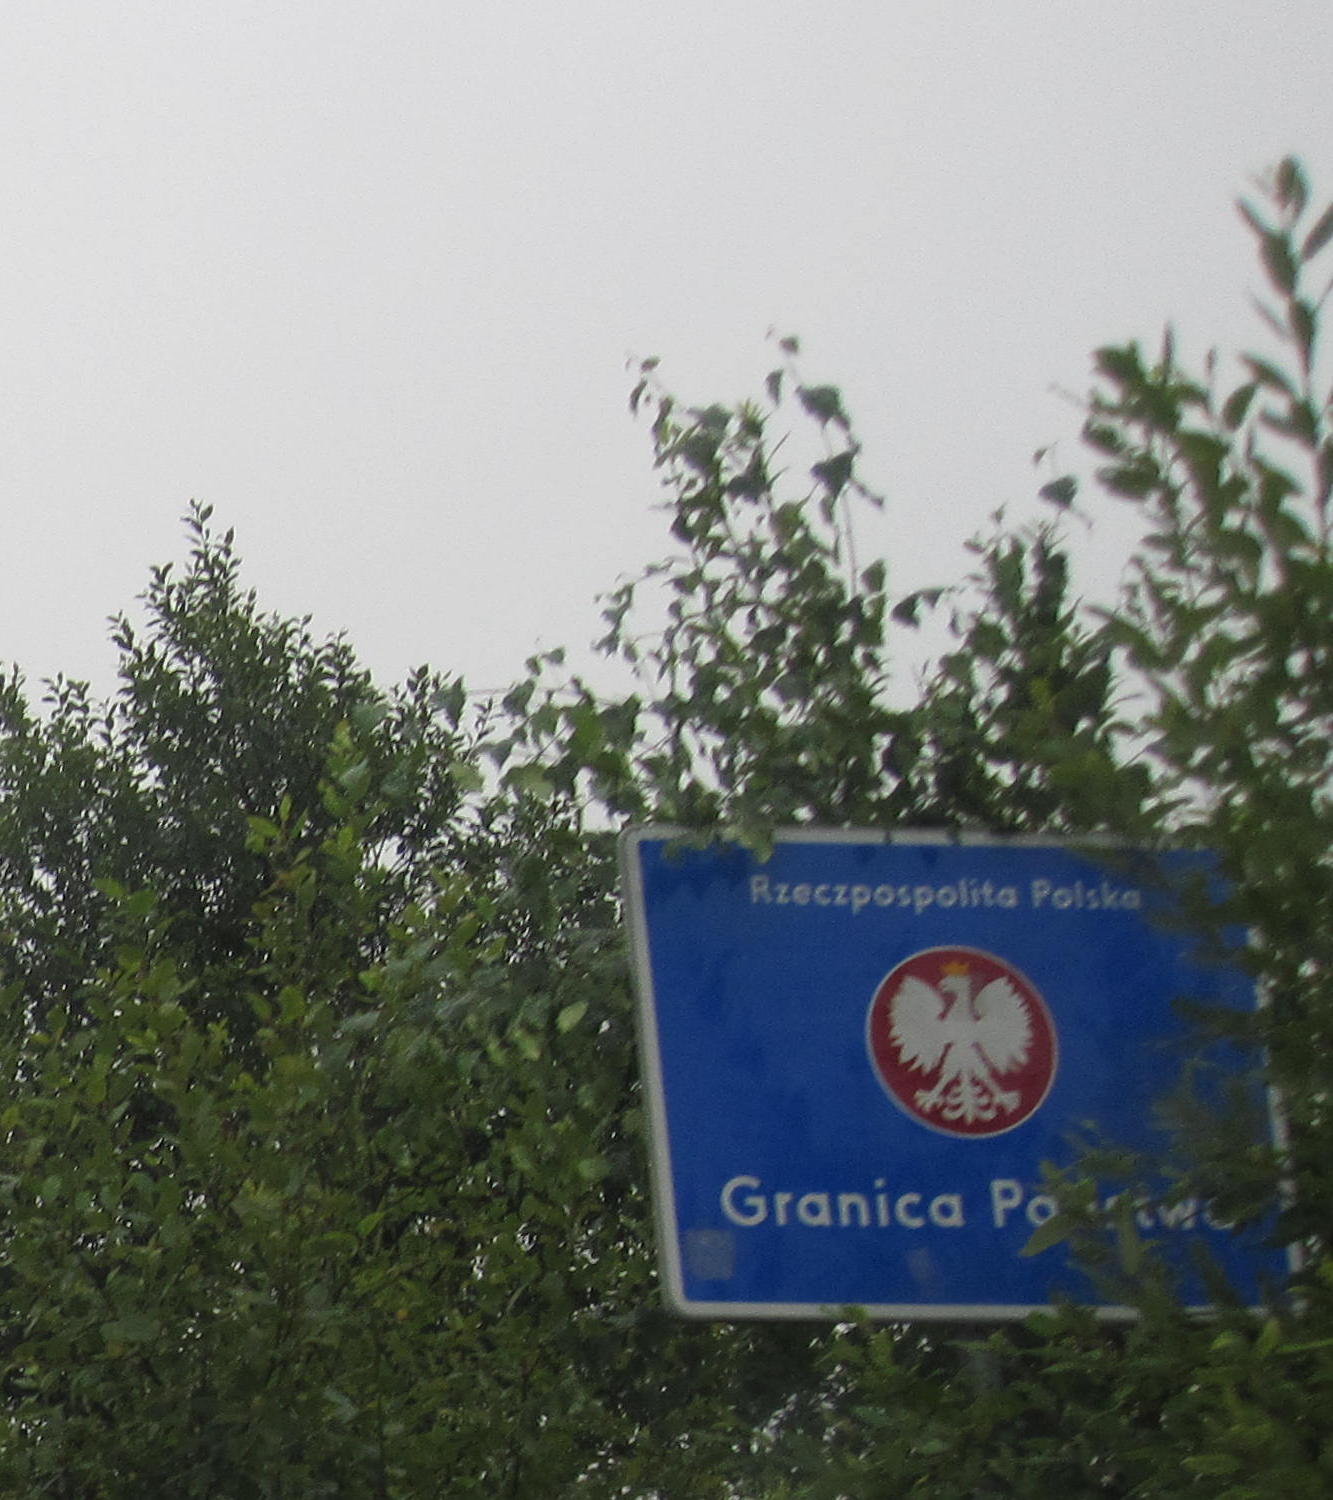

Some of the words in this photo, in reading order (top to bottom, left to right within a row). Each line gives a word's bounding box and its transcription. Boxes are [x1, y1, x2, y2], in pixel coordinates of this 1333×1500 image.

[749, 874, 1018, 914] Rzeczpospolita
[1032, 878, 1142, 910] Polska
[720, 1174, 965, 1228] Granica
